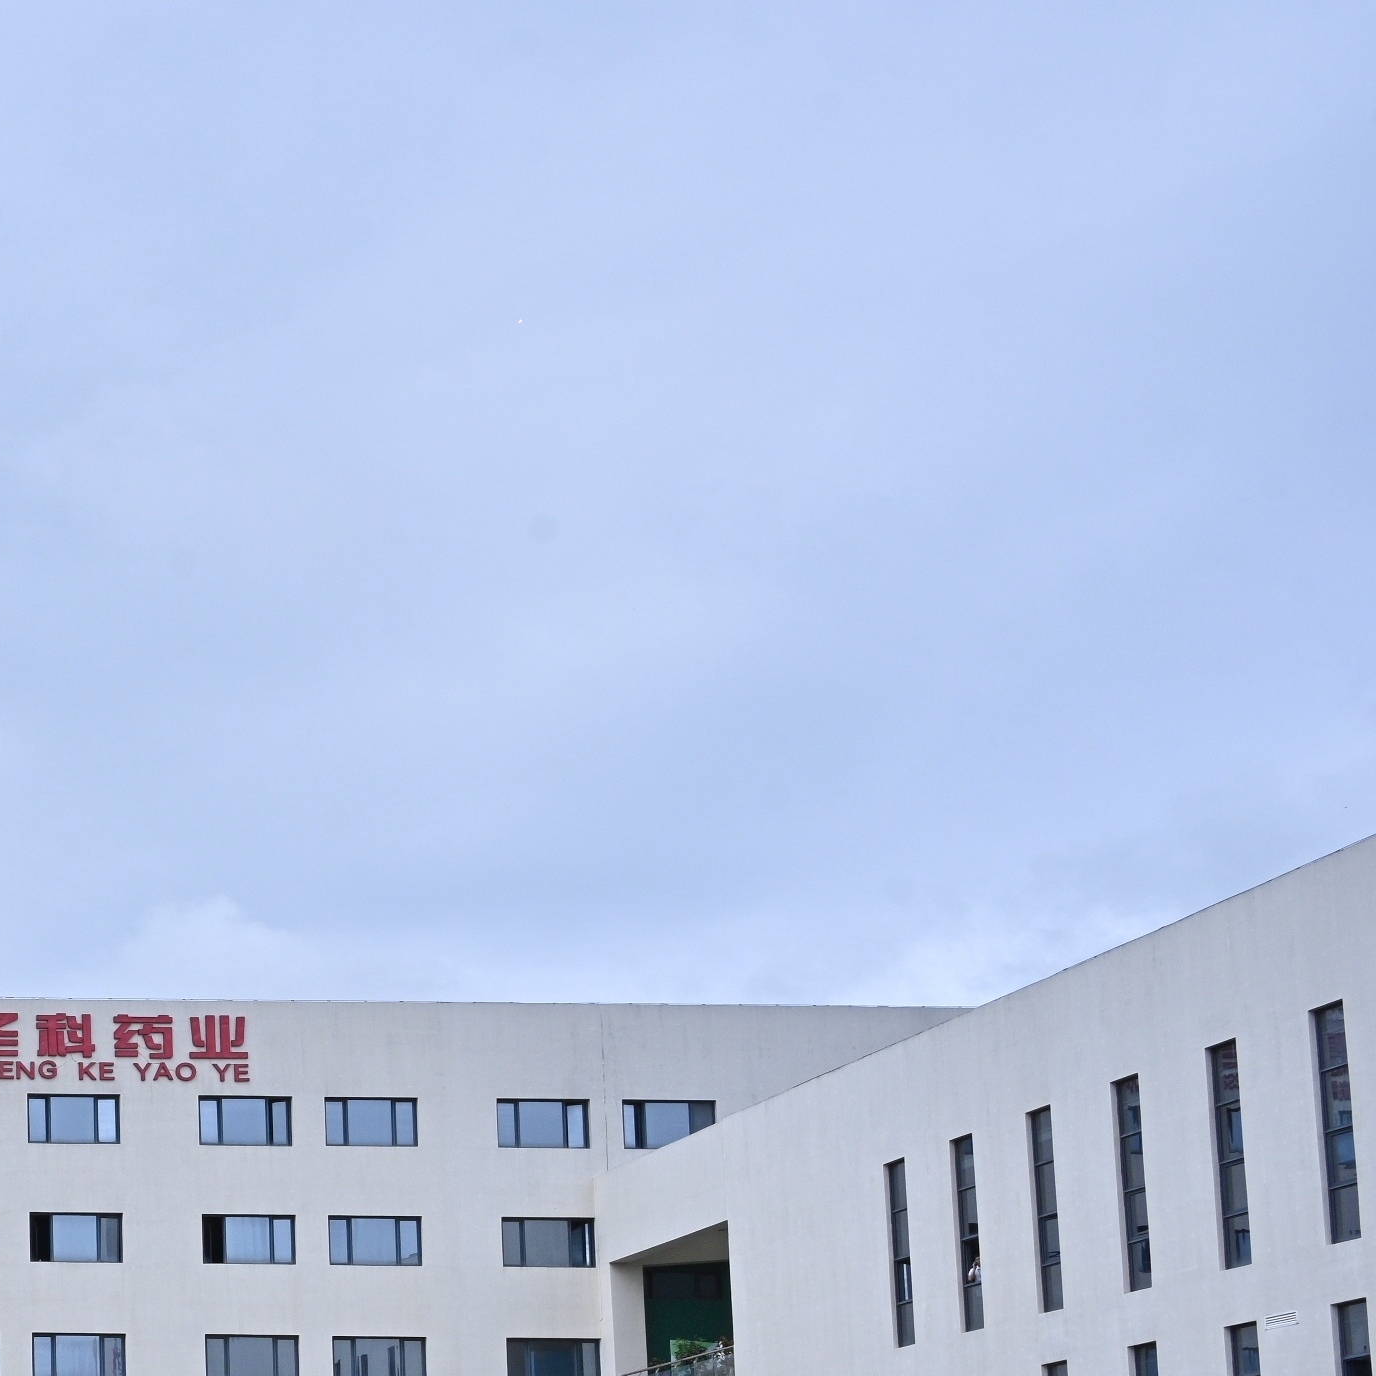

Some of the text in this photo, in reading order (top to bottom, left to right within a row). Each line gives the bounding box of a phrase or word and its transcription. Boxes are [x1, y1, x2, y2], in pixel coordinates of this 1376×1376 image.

[78, 1061, 116, 1081] KE
[133, 1061, 197, 1082] YAO
[212, 1062, 250, 1082] YE
